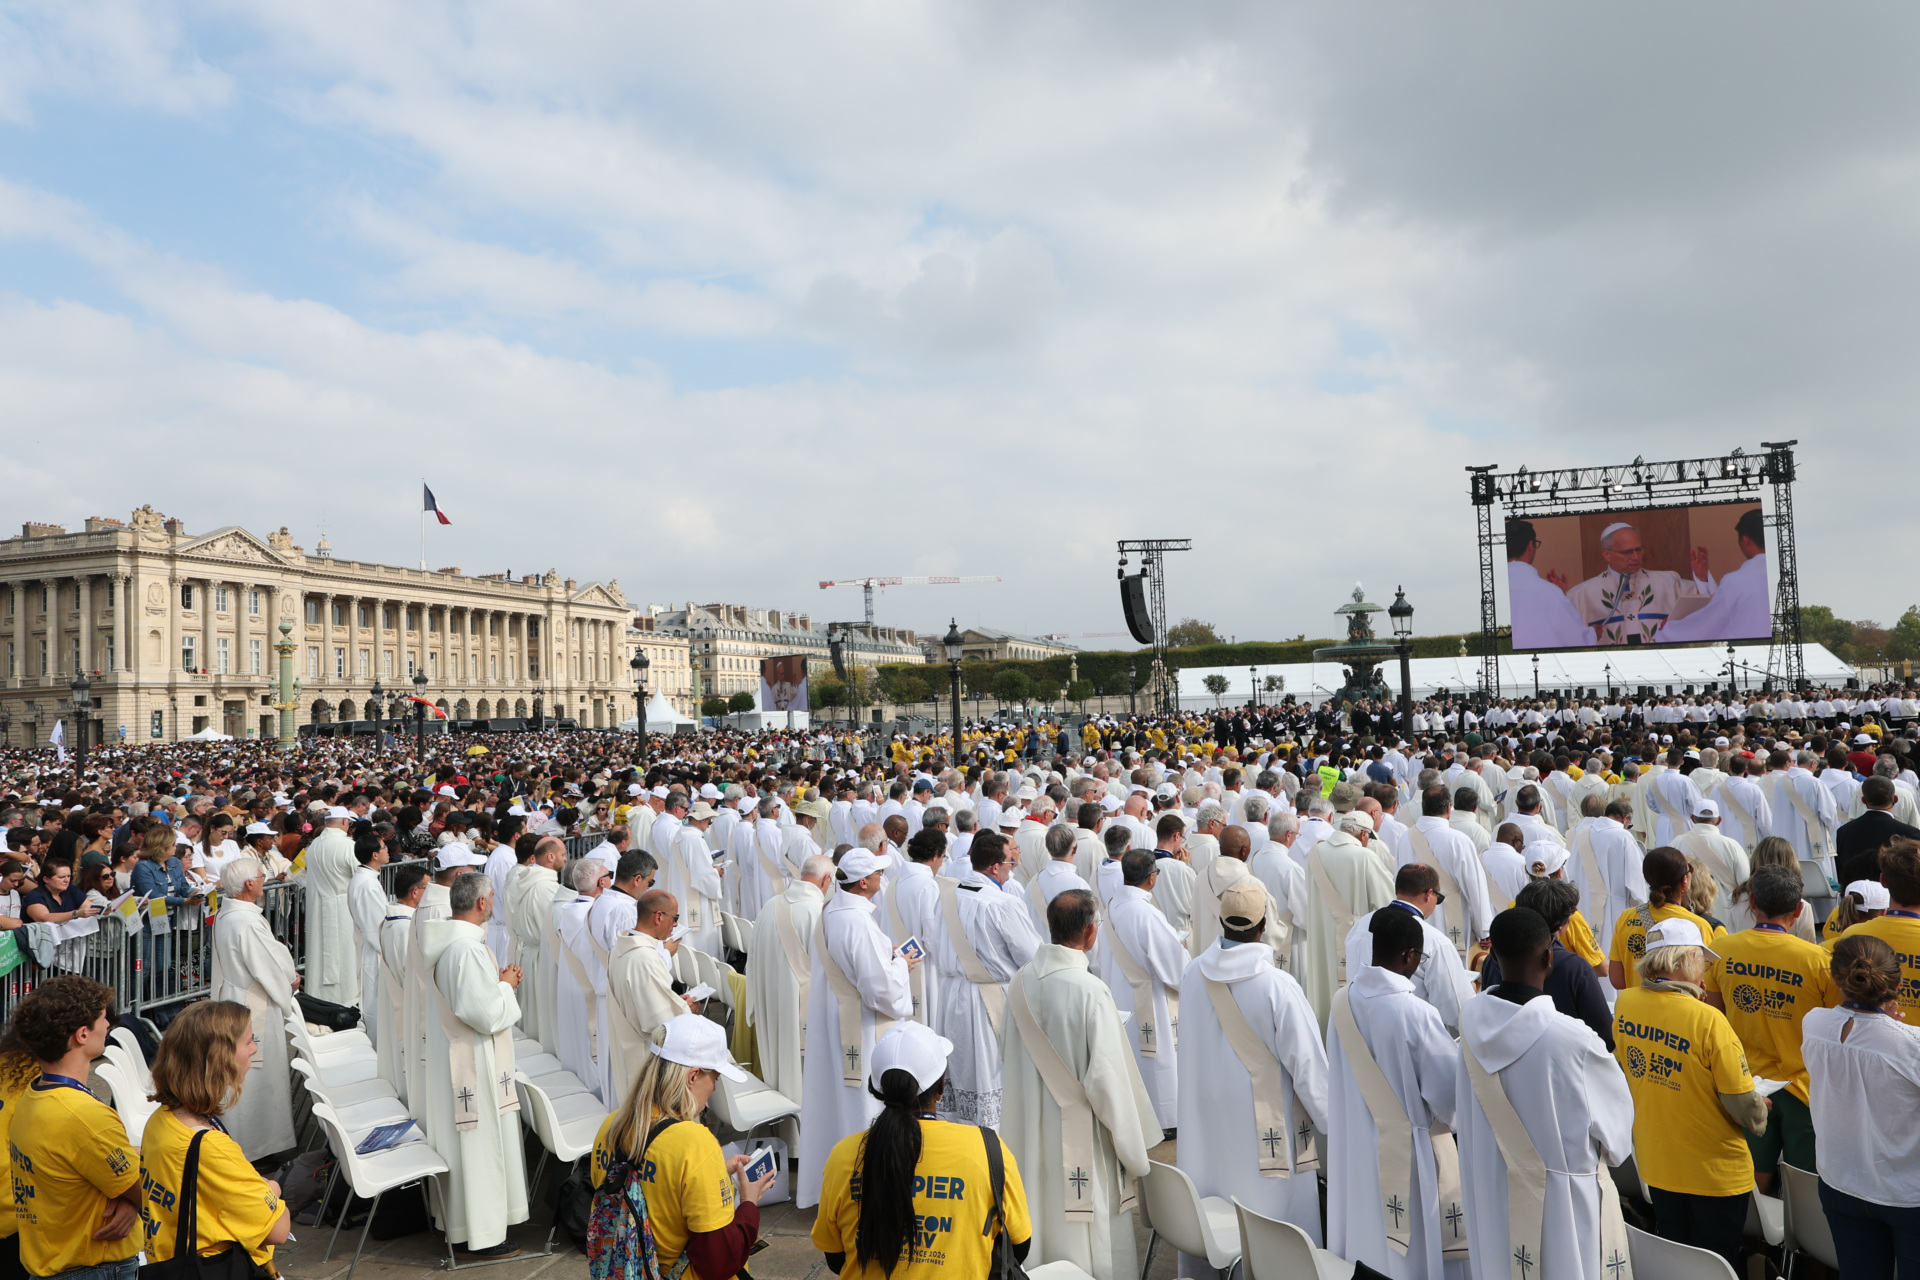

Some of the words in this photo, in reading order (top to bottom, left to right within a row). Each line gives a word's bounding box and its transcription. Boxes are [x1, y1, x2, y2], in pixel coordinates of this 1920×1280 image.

[1726, 957, 1803, 988] ÉQUIPIER
[1764, 989, 1795, 1004] LEON
[1764, 997, 1785, 1010] XIV
[1619, 1015, 1690, 1055] ÉQUIPIER
[1650, 1052, 1682, 1072] LEON
[1649, 1063, 1672, 1078] XIV
[1648, 1073, 1667, 1084] FRANCE
[914, 1215, 952, 1232] EON
[915, 1258, 944, 1266] SEPTEMBRE
[929, 1250, 946, 1259] 2026
